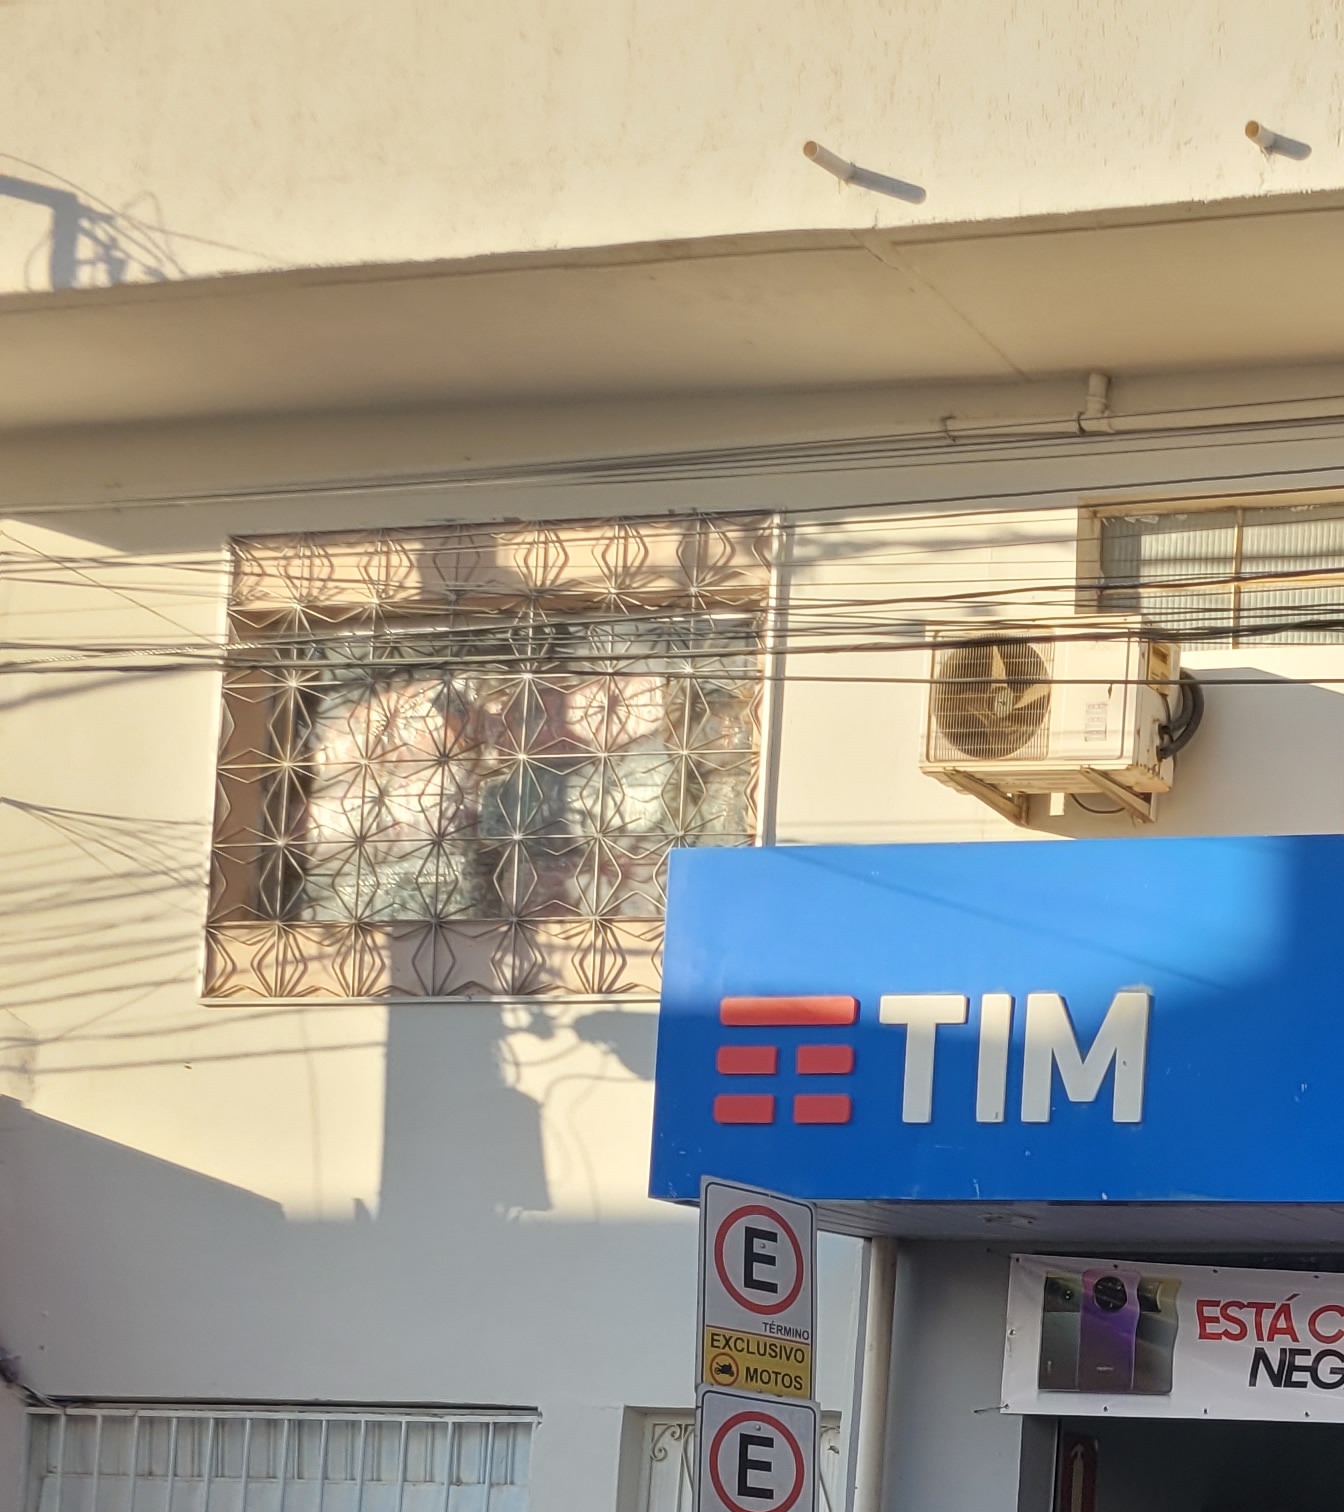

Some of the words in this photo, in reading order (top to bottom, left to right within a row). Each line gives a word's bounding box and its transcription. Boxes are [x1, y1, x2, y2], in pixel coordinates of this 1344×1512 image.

[879, 992, 1151, 1124] TIM
[744, 1226, 778, 1294] E
[762, 1320, 810, 1340] TÉRMINO
[1197, 1294, 1300, 1342] ESTÁ
[710, 1332, 805, 1364] EXCLUSIVO
[744, 1366, 803, 1391] MOTOS
[737, 1432, 774, 1499] E
